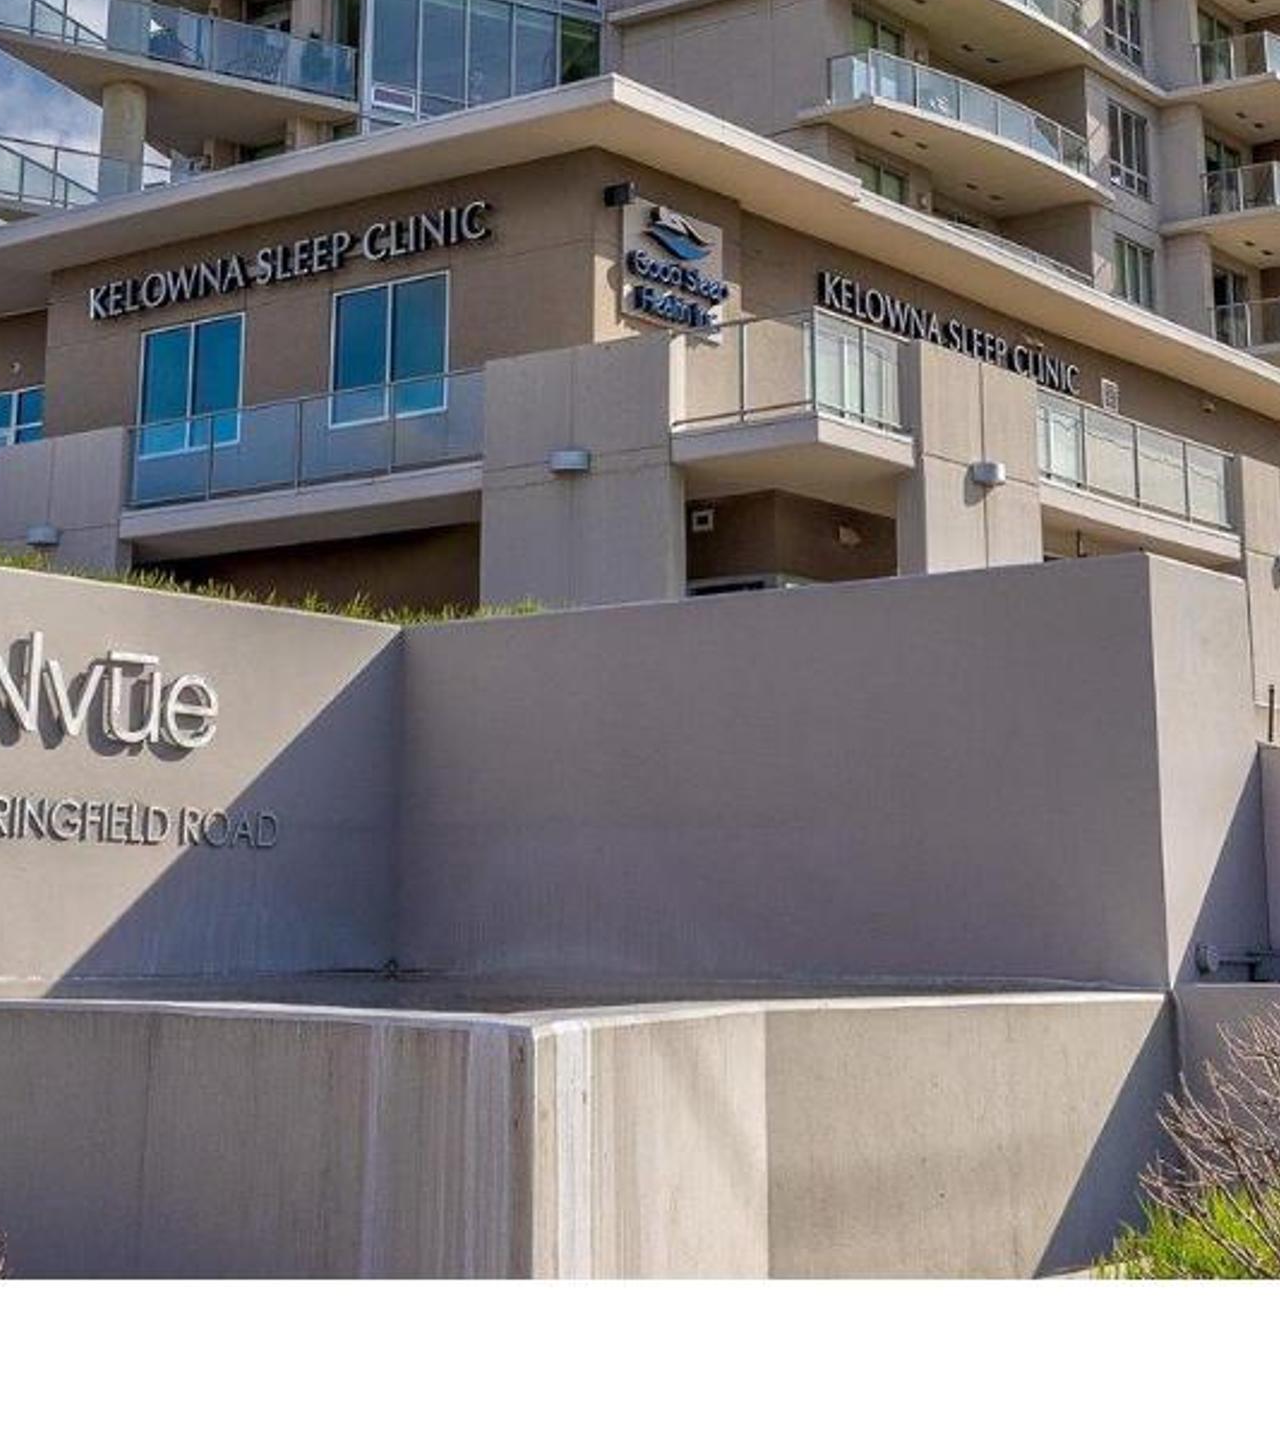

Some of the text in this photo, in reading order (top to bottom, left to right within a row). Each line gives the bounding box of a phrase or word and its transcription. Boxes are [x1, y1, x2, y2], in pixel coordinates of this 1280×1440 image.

[88, 200, 488, 320] KELOWNA SLEEP CLINIC
[821, 271, 1081, 394] KELOWNA SLEEP CLINIC
[178, 806, 279, 849] ROAD
